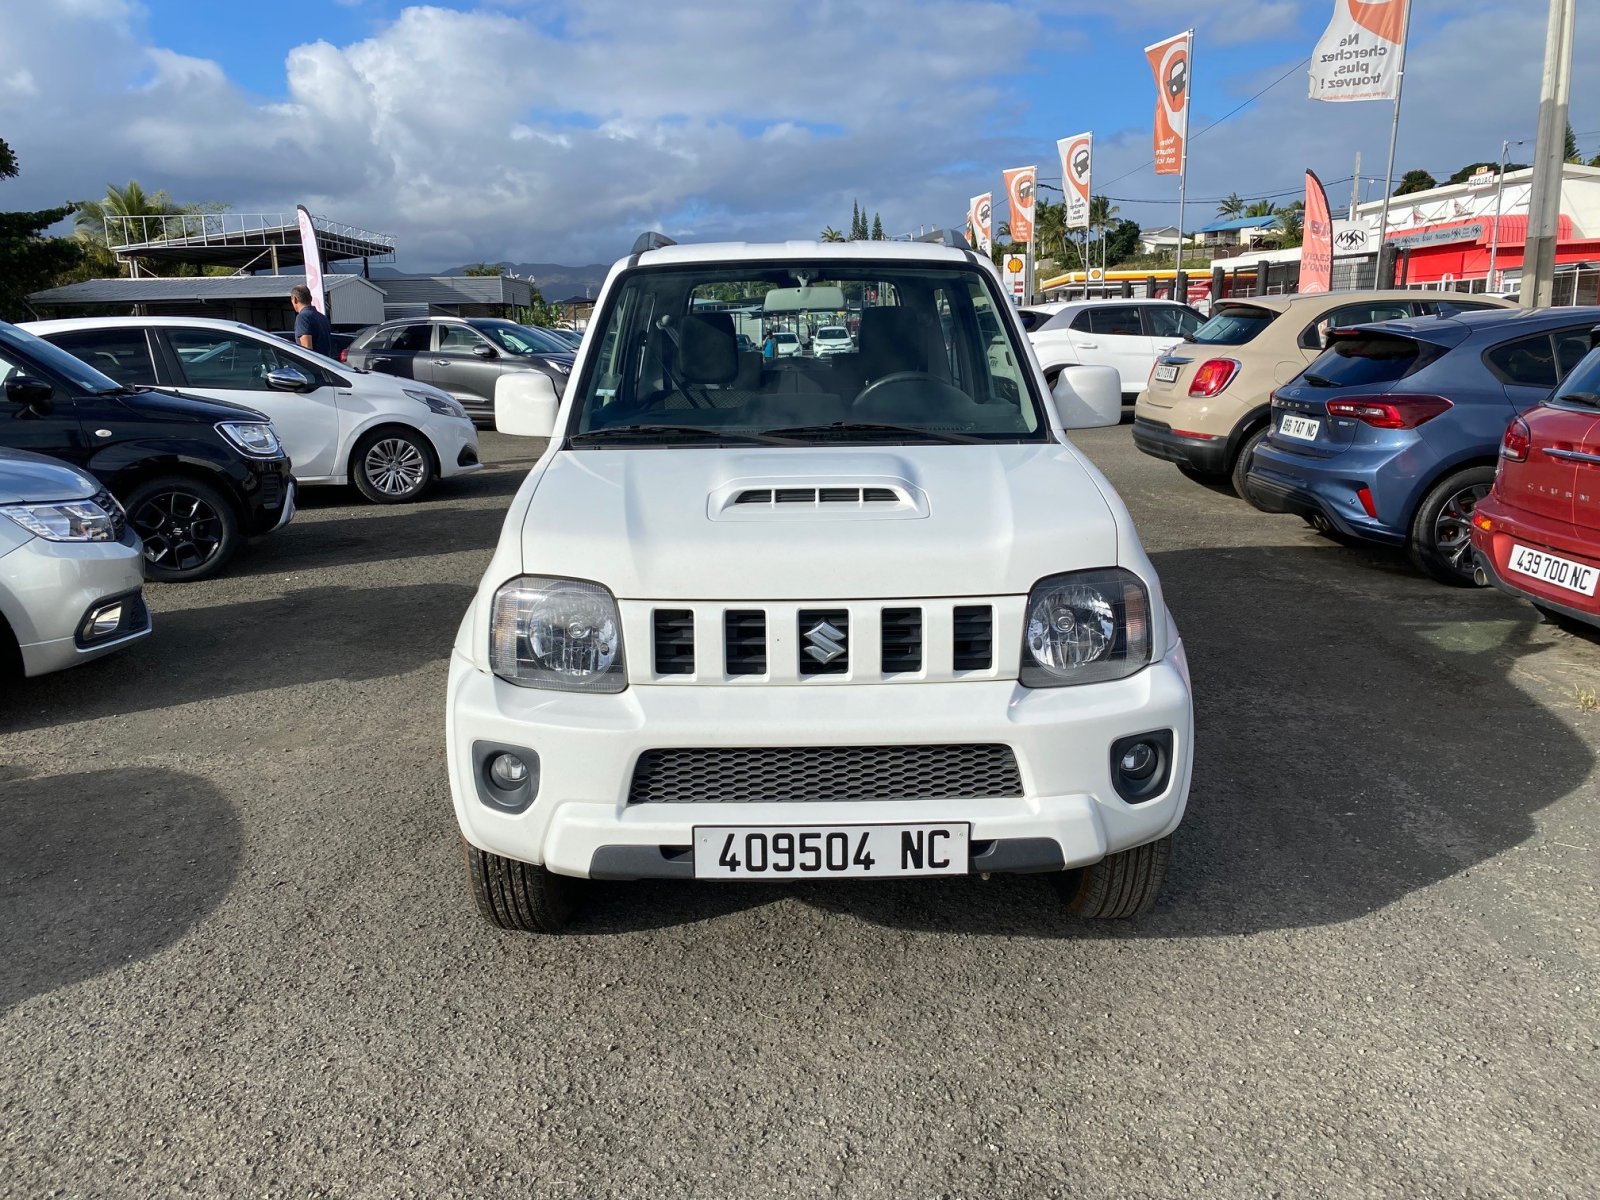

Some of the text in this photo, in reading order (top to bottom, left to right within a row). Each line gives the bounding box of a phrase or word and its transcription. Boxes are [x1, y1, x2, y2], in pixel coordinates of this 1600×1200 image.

[1335, 230, 1364, 247] MSN
[1305, 422, 1317, 437] NC
[1517, 550, 1591, 590] 439 700 NC
[718, 830, 950, 872] 409504 NC
